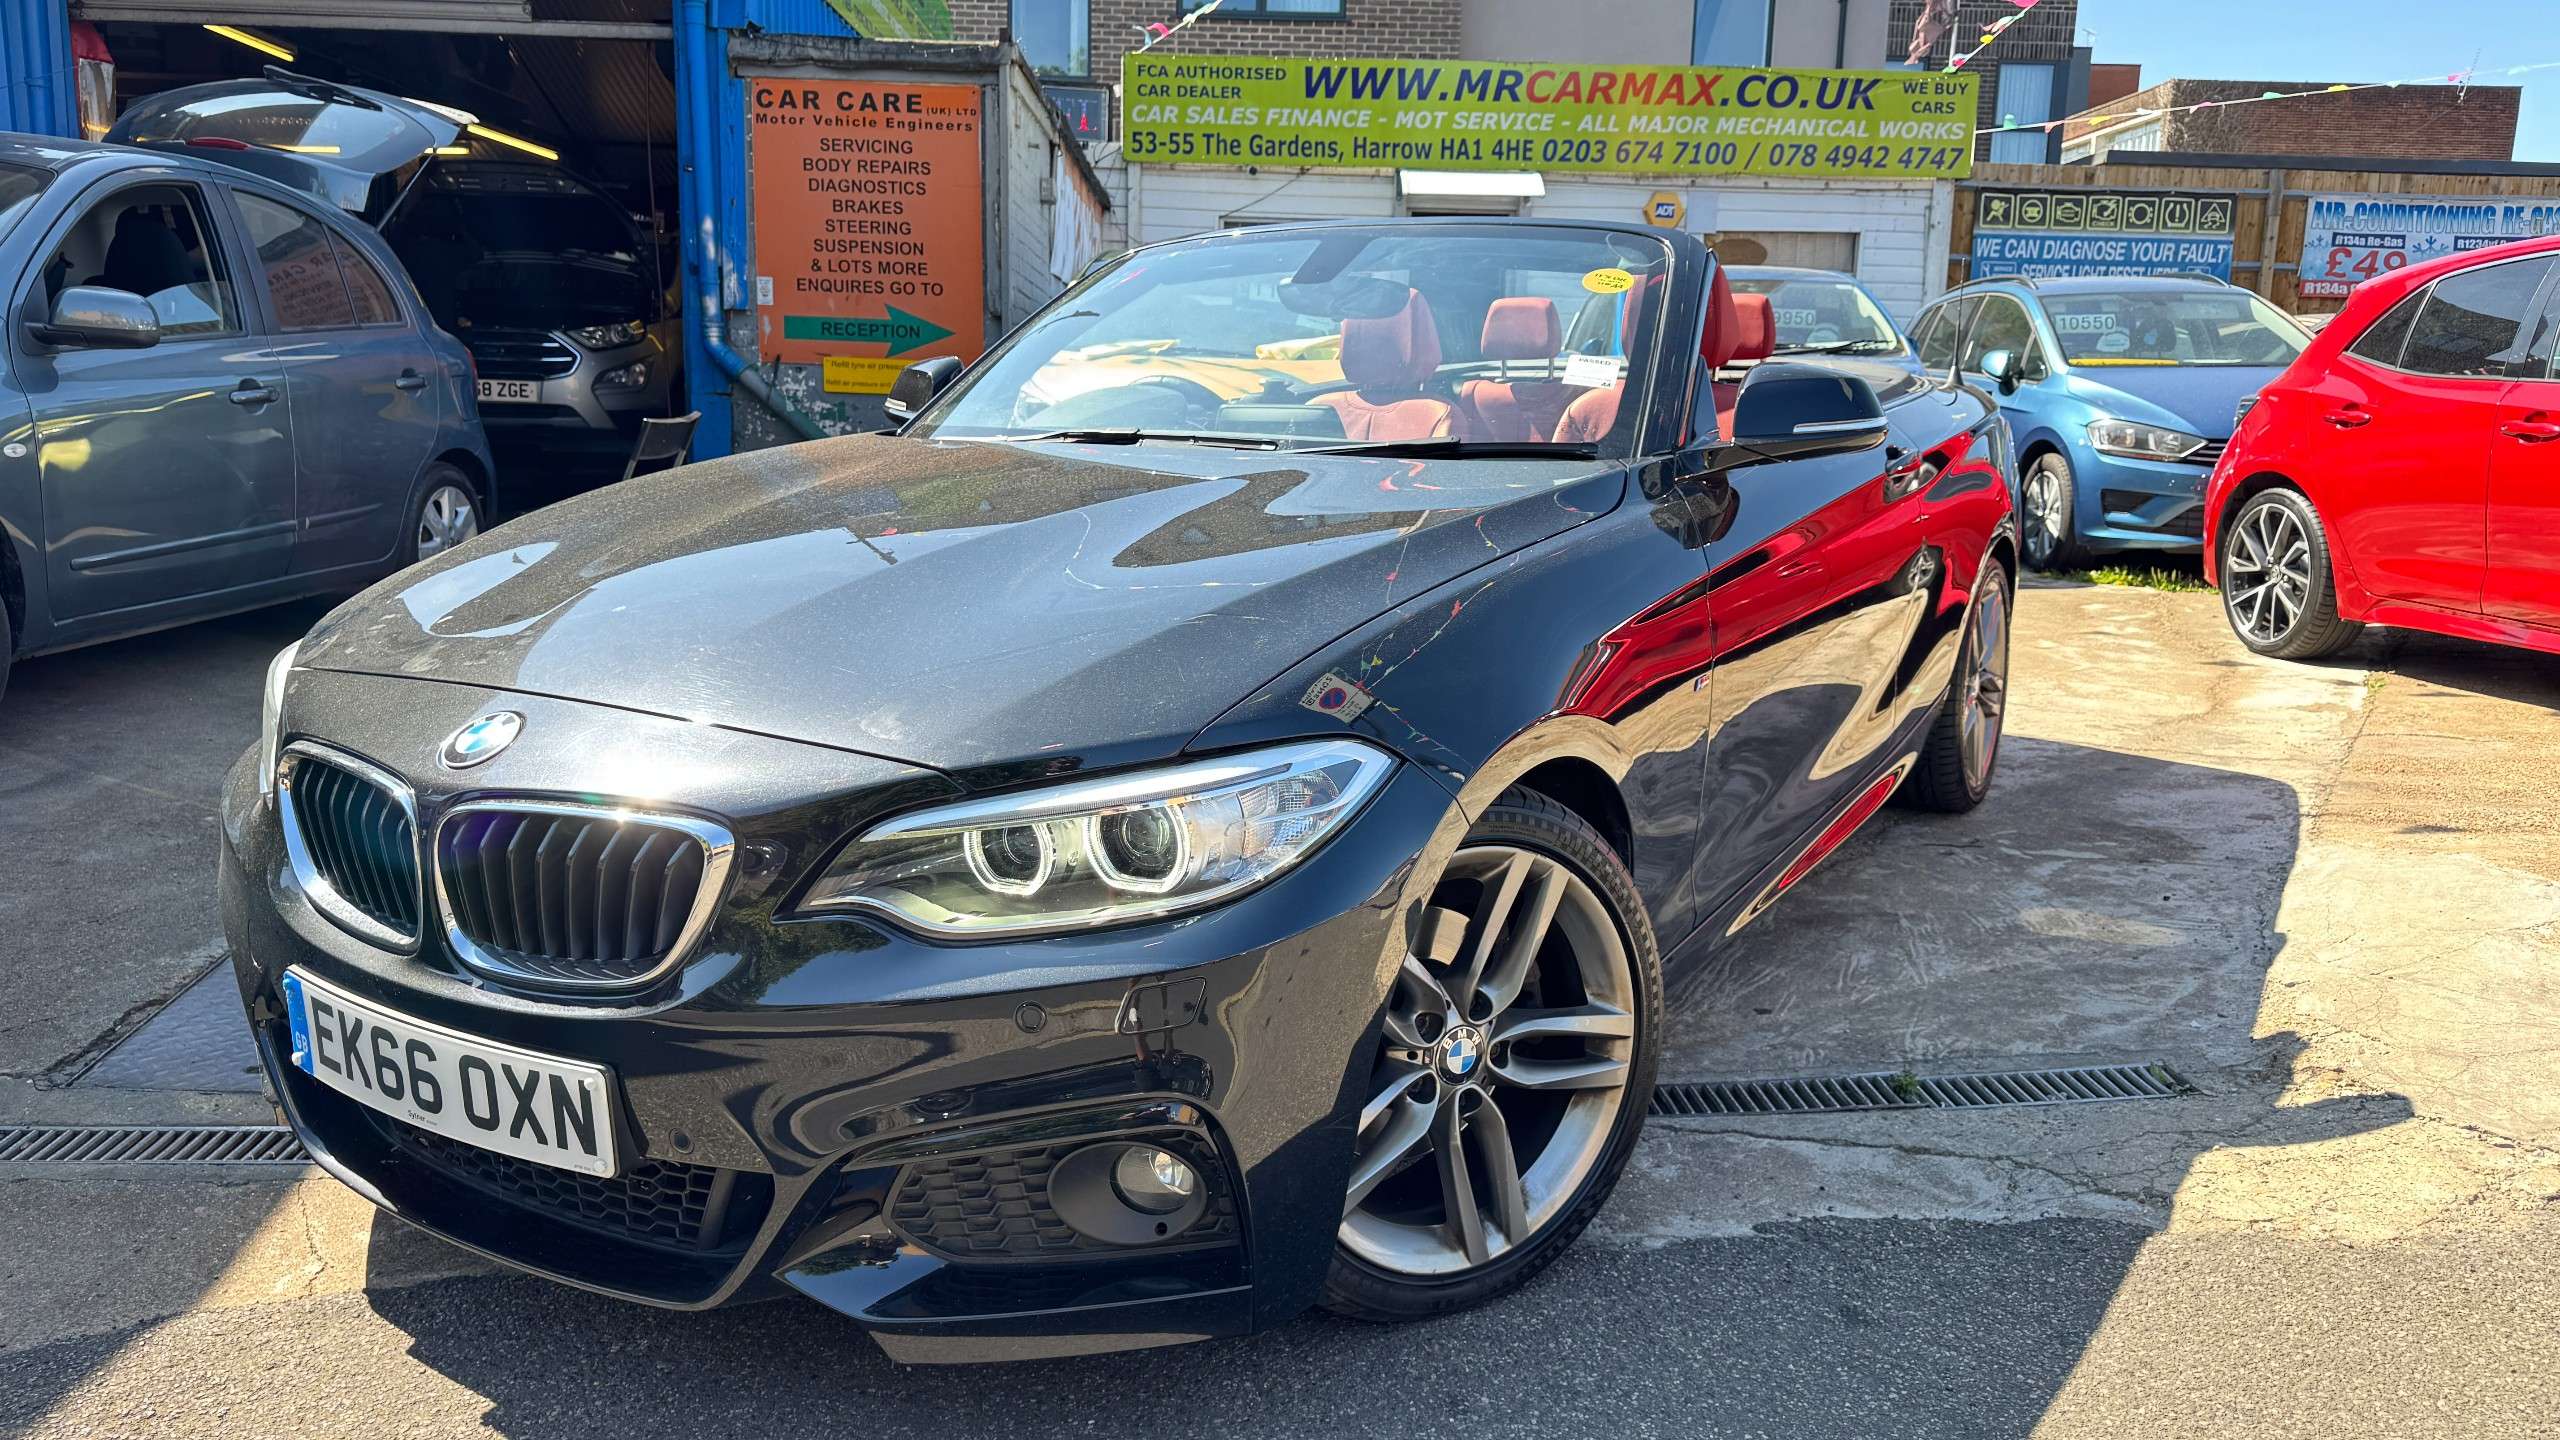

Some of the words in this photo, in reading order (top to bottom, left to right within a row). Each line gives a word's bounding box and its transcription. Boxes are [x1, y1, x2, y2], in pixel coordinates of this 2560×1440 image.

[1137, 64, 1168, 78] FCA
[1174, 66, 1286, 81] AUTHORISED
[1137, 83, 1171, 98] CAR
[1178, 85, 1241, 100] DEALER
[1305, 65, 1882, 111] WWW.MRCARMAX.CO.UK
[1903, 80, 1929, 95] WE
[1935, 82, 1969, 96] BUY
[755, 88, 820, 110] CAR
[836, 91, 923, 113] CARE
[926, 107, 951, 116] (UK)
[956, 108, 977, 117] LTD
[1911, 101, 1956, 115] CARS
[756, 113, 805, 125] Motor
[813, 115, 877, 128] Vehicle
[886, 118, 973, 132] Engineers
[1132, 105, 1177, 124] CAR
[1185, 107, 1259, 126] SALES
[1266, 108, 1371, 128] FINANCE
[1395, 110, 1442, 130] MOT
[1453, 112, 1554, 132] SERVICE
[1578, 115, 1618, 133] ALL
[1628, 115, 1707, 135] MAJOR
[1716, 117, 1870, 138] MECHANICAL
[1879, 121, 1966, 140] WORKS
[820, 138, 913, 154] SERVICING
[1131, 132, 1195, 155] 53-55
[1202, 134, 1241, 156] The
[1248, 134, 1344, 163] Gardens,
[1353, 136, 1432, 161] Harrow
[1440, 137, 1483, 161] HA1
[1492, 138, 1533, 162] 4HE
[1541, 139, 1607, 164] 0203
[1615, 140, 1664, 165] 674
[1673, 141, 1737, 166] 7100
[1744, 142, 1761, 170] /
[1768, 143, 1816, 168] 078
[1825, 144, 1890, 169] 4942
[1898, 146, 1966, 171] 4747
[803, 157, 851, 173] BODY
[857, 159, 931, 176] REPAIRS
[808, 178, 926, 196] DIAGNOSTICS
[832, 199, 904, 215] BRAKES
[1656, 204, 1675, 217] ADT
[2311, 200, 2497, 234] AIR-CONDITIONING
[825, 219, 912, 235] STEERING
[814, 239, 924, 256] SUSPENSION
[2335, 235, 2366, 246] R134a
[2367, 236, 2404, 248] Re-Gas
[1976, 238, 2002, 257] WE
[2004, 240, 2040, 259] CAN
[2043, 240, 2127, 261] DIAGNOSE
[2131, 242, 2175, 262] YOUR
[2178, 243, 2229, 264] FAULT
[811, 258, 822, 272] &
[828, 259, 872, 274] LOTS
[878, 261, 928, 276] MORE
[796, 278, 884, 294] ENQUIRES
[890, 281, 915, 295] GO
[920, 282, 944, 296] TO
[821, 320, 921, 339] RECEPTION
[2060, 316, 2115, 330] 10550
[497, 382, 529, 398] ZGE
[295, 1031, 308, 1053] GB
[1443, 1028, 1481, 1050] BMW
[310, 996, 442, 1115] EK66
[458, 1054, 598, 1157] OXN
